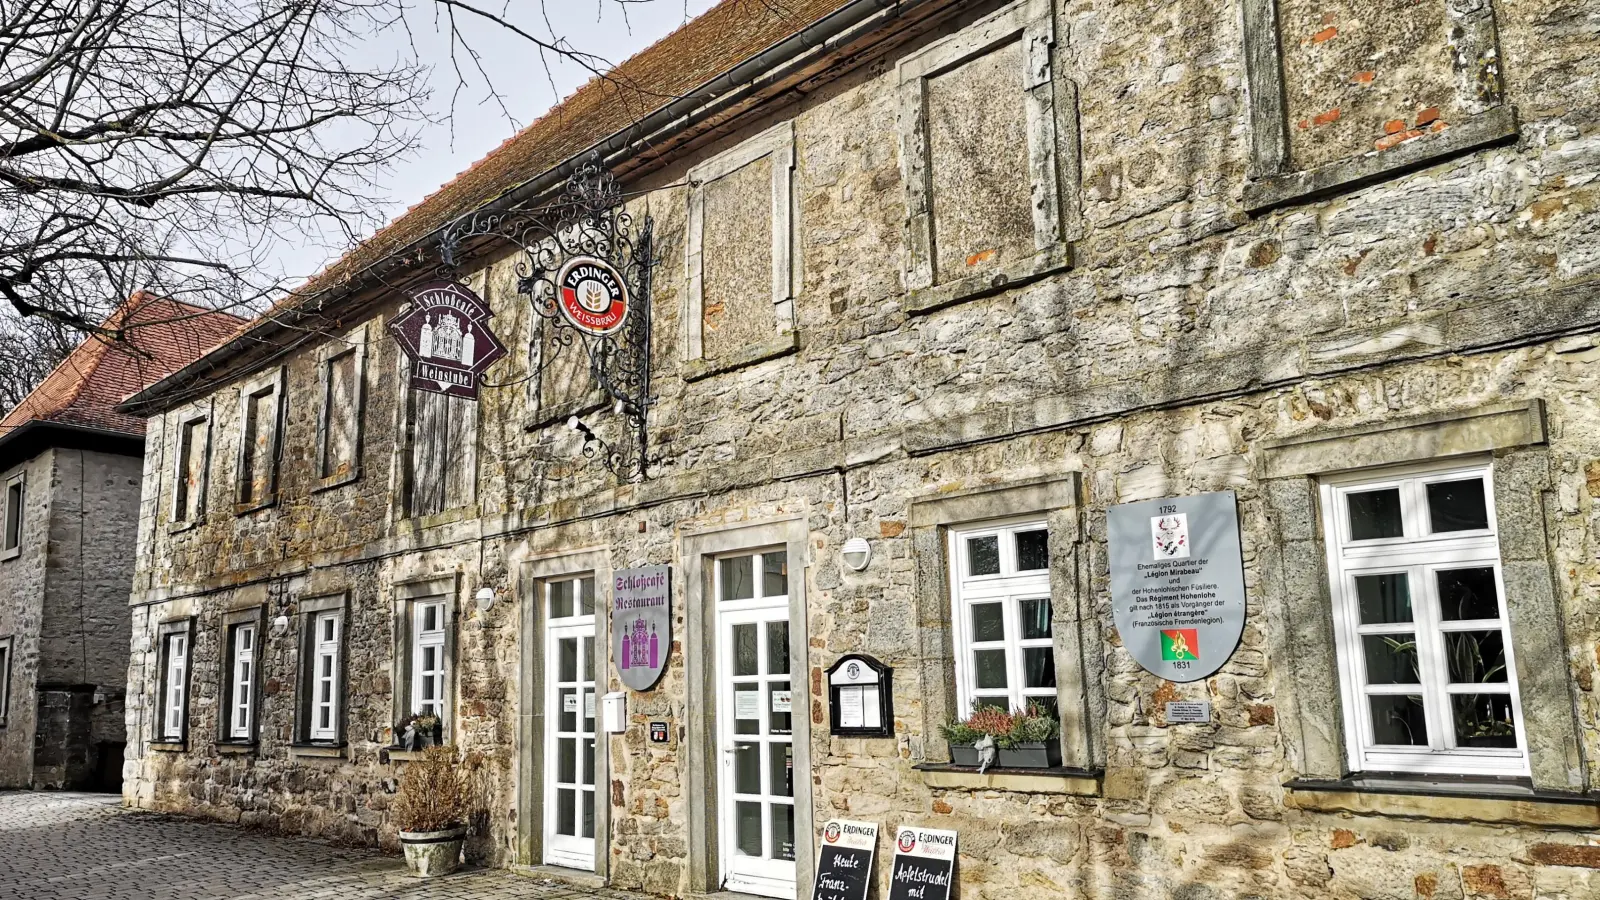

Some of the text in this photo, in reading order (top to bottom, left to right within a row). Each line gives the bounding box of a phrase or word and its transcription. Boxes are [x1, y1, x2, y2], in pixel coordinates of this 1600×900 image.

[568, 267, 620, 297] ERDINGER
[422, 291, 477, 317] Schloßcafé
[422, 364, 469, 386] Weinstube
[1159, 505, 1177, 514] 1792
[1137, 563, 1171, 571] Ehemaliges
[1172, 560, 1197, 568] Quartier
[616, 572, 665, 592] Schloßcafé
[615, 594, 665, 611] Restaurant
[1149, 594, 1180, 602] Régiment
[1180, 592, 1216, 600] Hohenlohe
[1180, 600, 1214, 609] Vorgänger
[1172, 661, 1191, 669] 1831
[843, 824, 875, 838] ERDINGER
[919, 832, 954, 847] ERDINGER
[833, 853, 859, 868] Heute
[895, 863, 949, 886] Apfelstrudel
[908, 885, 926, 900] mit
